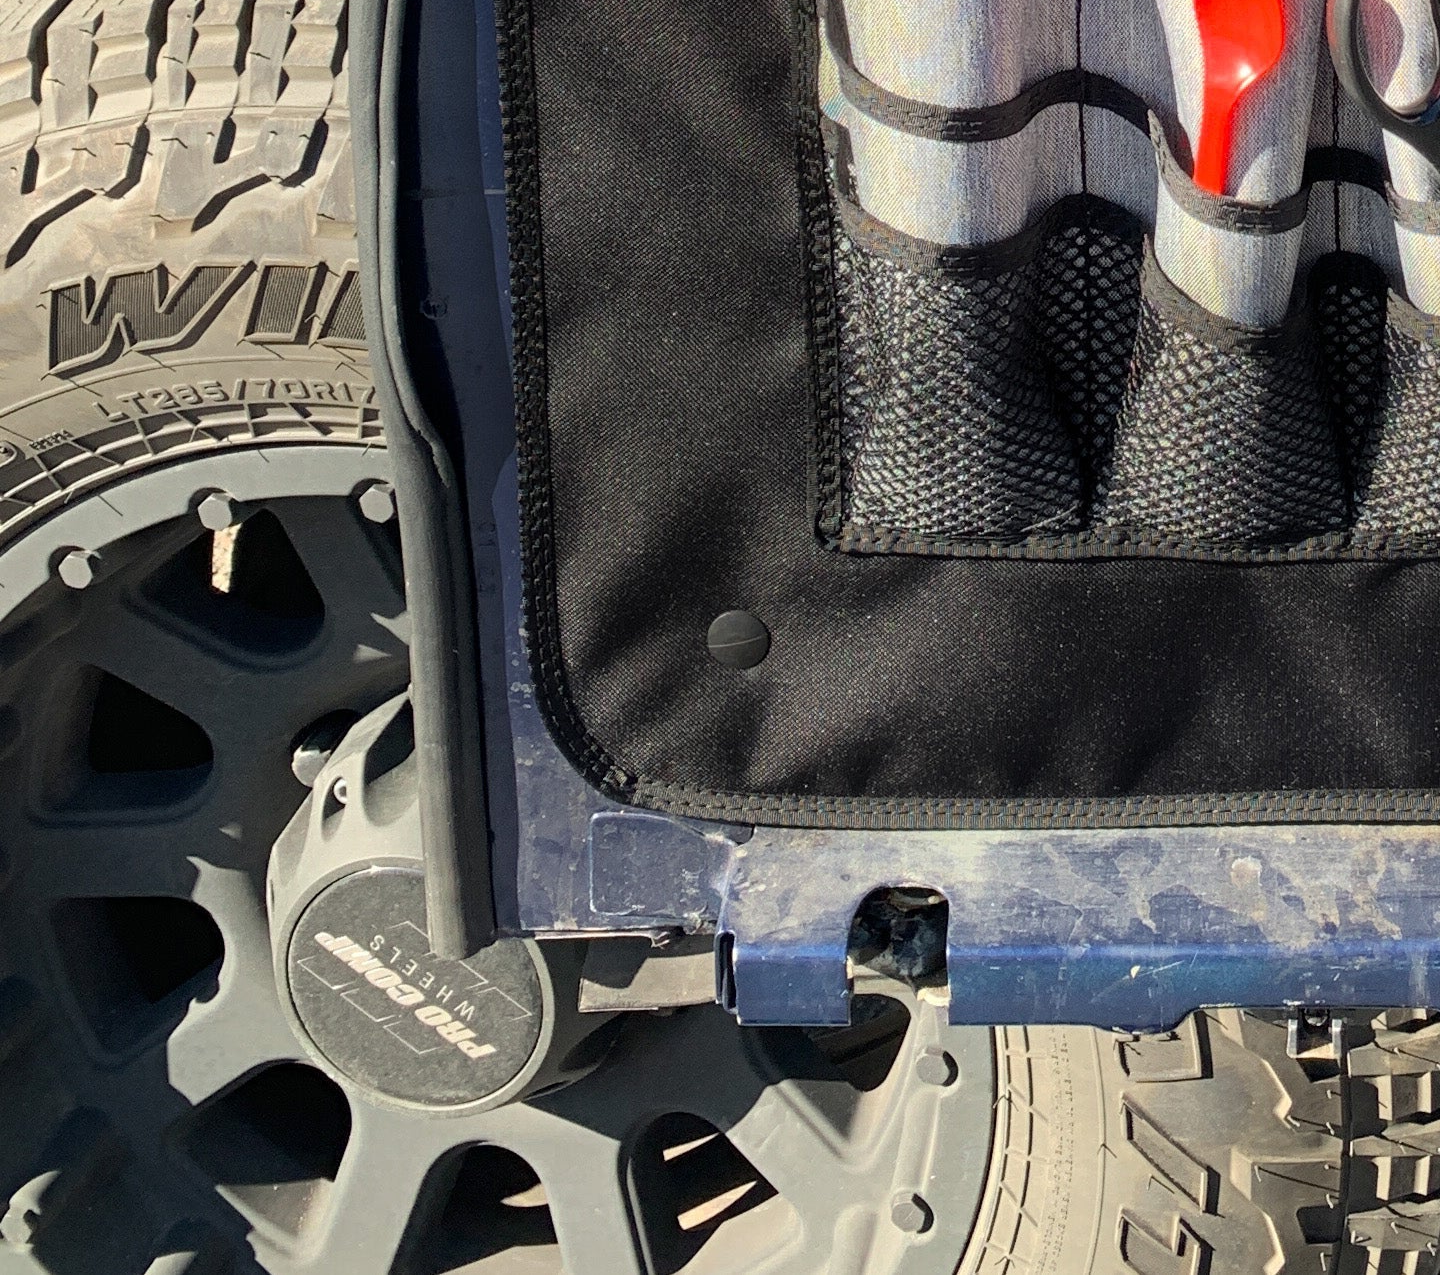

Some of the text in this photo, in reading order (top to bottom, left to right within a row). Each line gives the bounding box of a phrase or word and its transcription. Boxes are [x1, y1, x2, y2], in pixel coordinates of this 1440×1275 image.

[93, 377, 376, 423] LT285/70R17
[314, 931, 497, 1060] PRO COMP
[369, 934, 475, 1021] WHEELS
